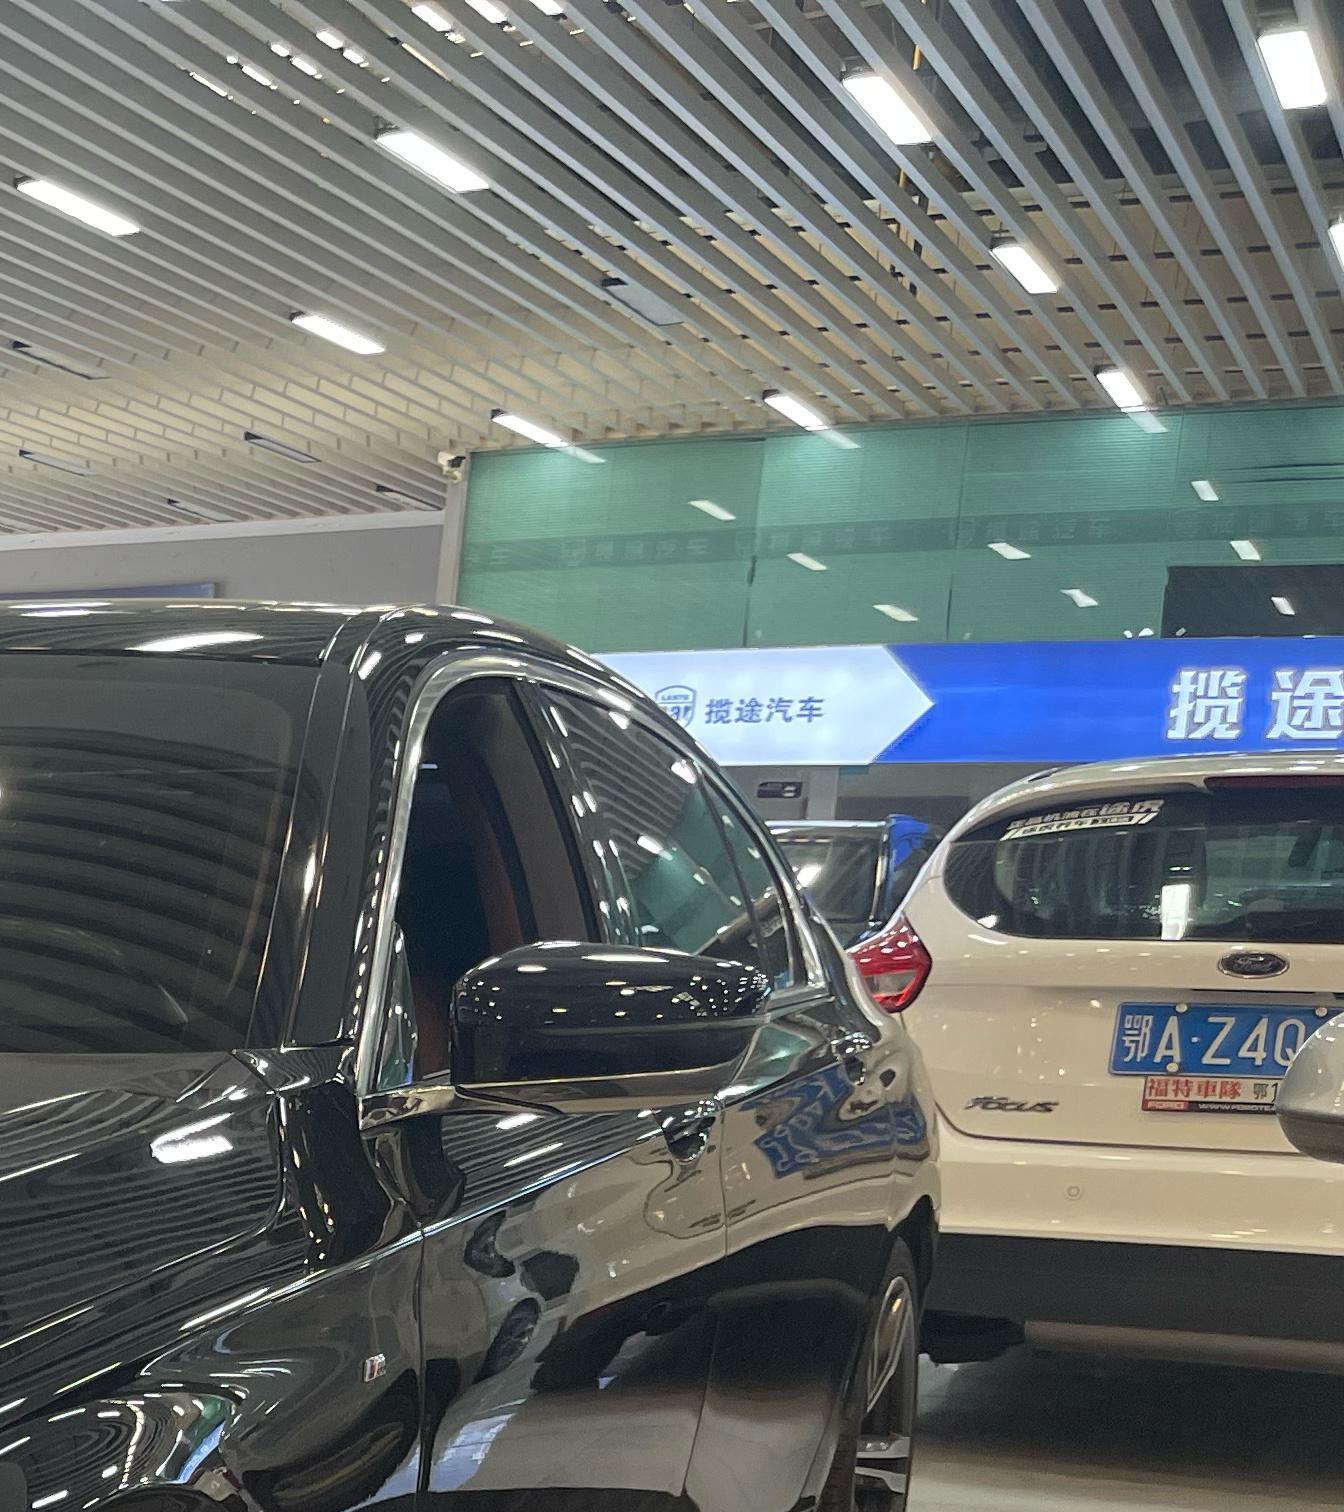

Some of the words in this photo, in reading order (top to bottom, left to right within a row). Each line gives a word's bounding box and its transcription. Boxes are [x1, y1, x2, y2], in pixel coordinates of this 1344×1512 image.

[704, 696, 824, 724] 揽途汽车
[1167, 670, 1344, 740] 揽途
[1148, 1078, 1242, 1100] 福特車隊
